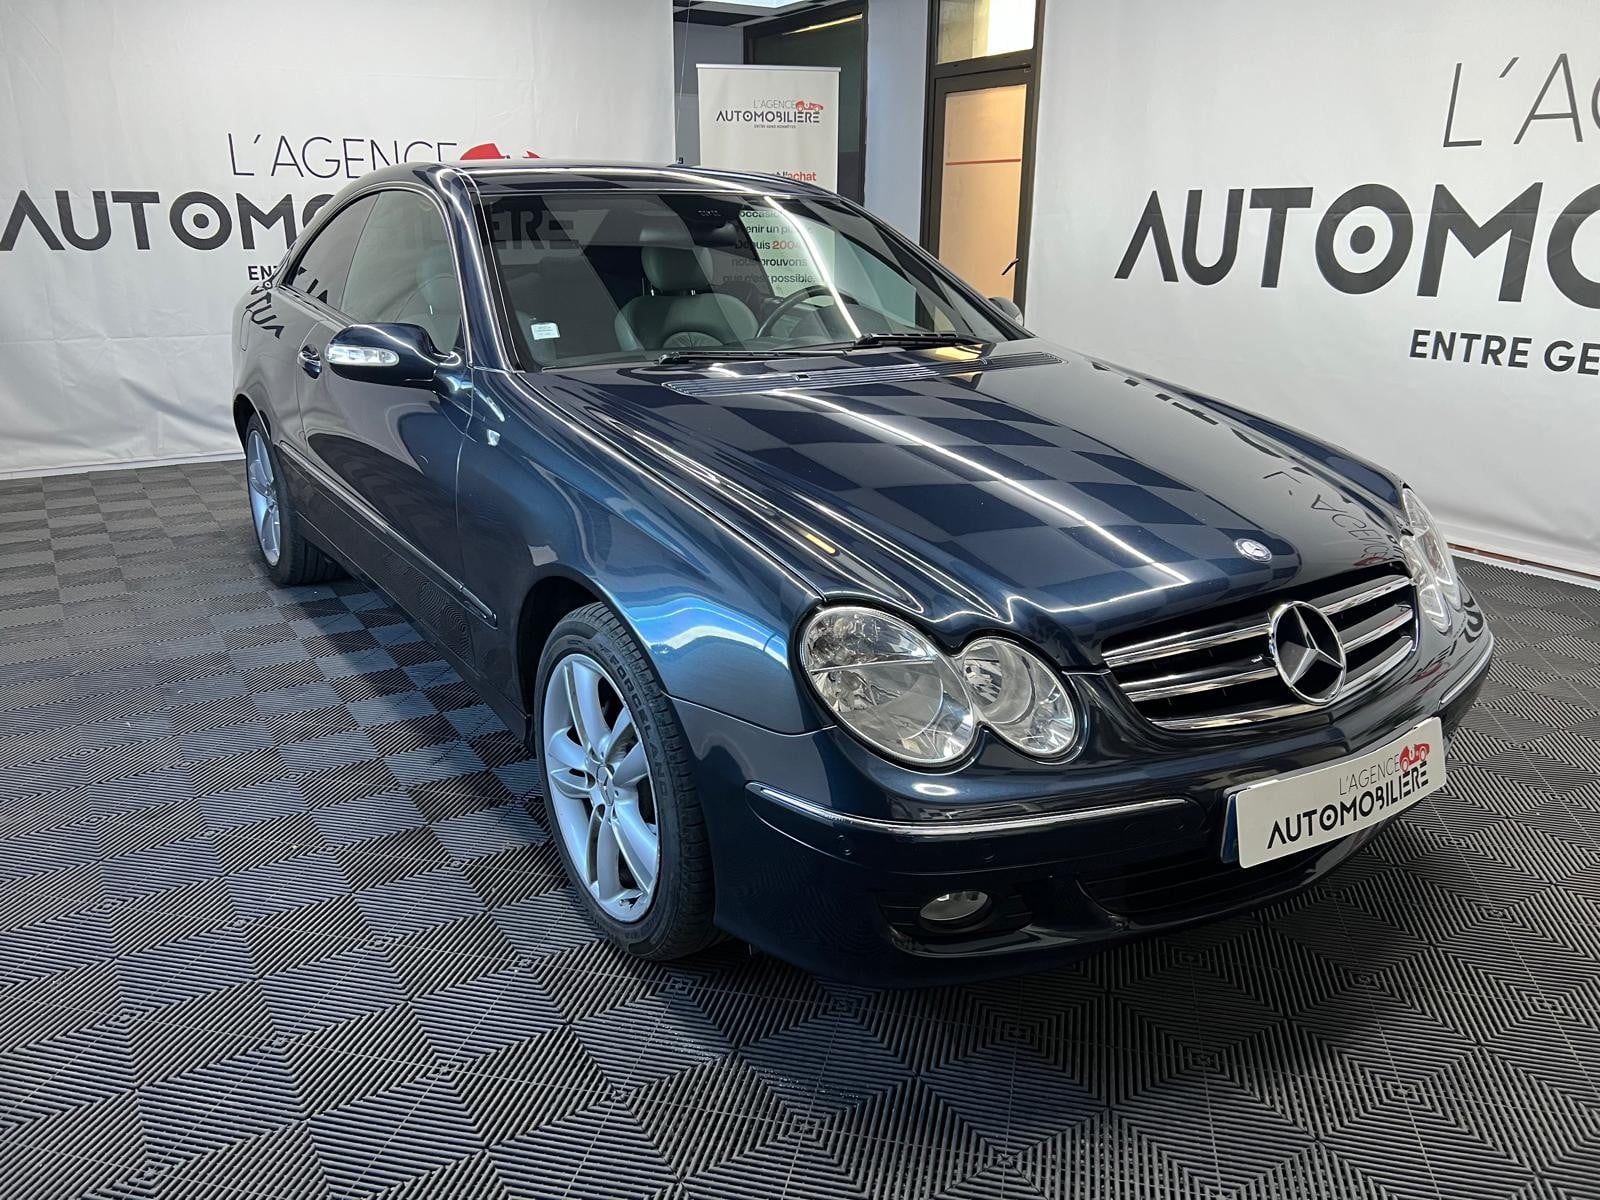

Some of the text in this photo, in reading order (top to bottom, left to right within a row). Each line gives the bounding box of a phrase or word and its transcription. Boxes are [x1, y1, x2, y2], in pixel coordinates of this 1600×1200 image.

[753, 99, 796, 109] L'AGENCE
[1443, 52, 1600, 148] L'A
[1409, 329, 1532, 369] ENTRE
[1338, 753, 1400, 796] L'AGENCE
